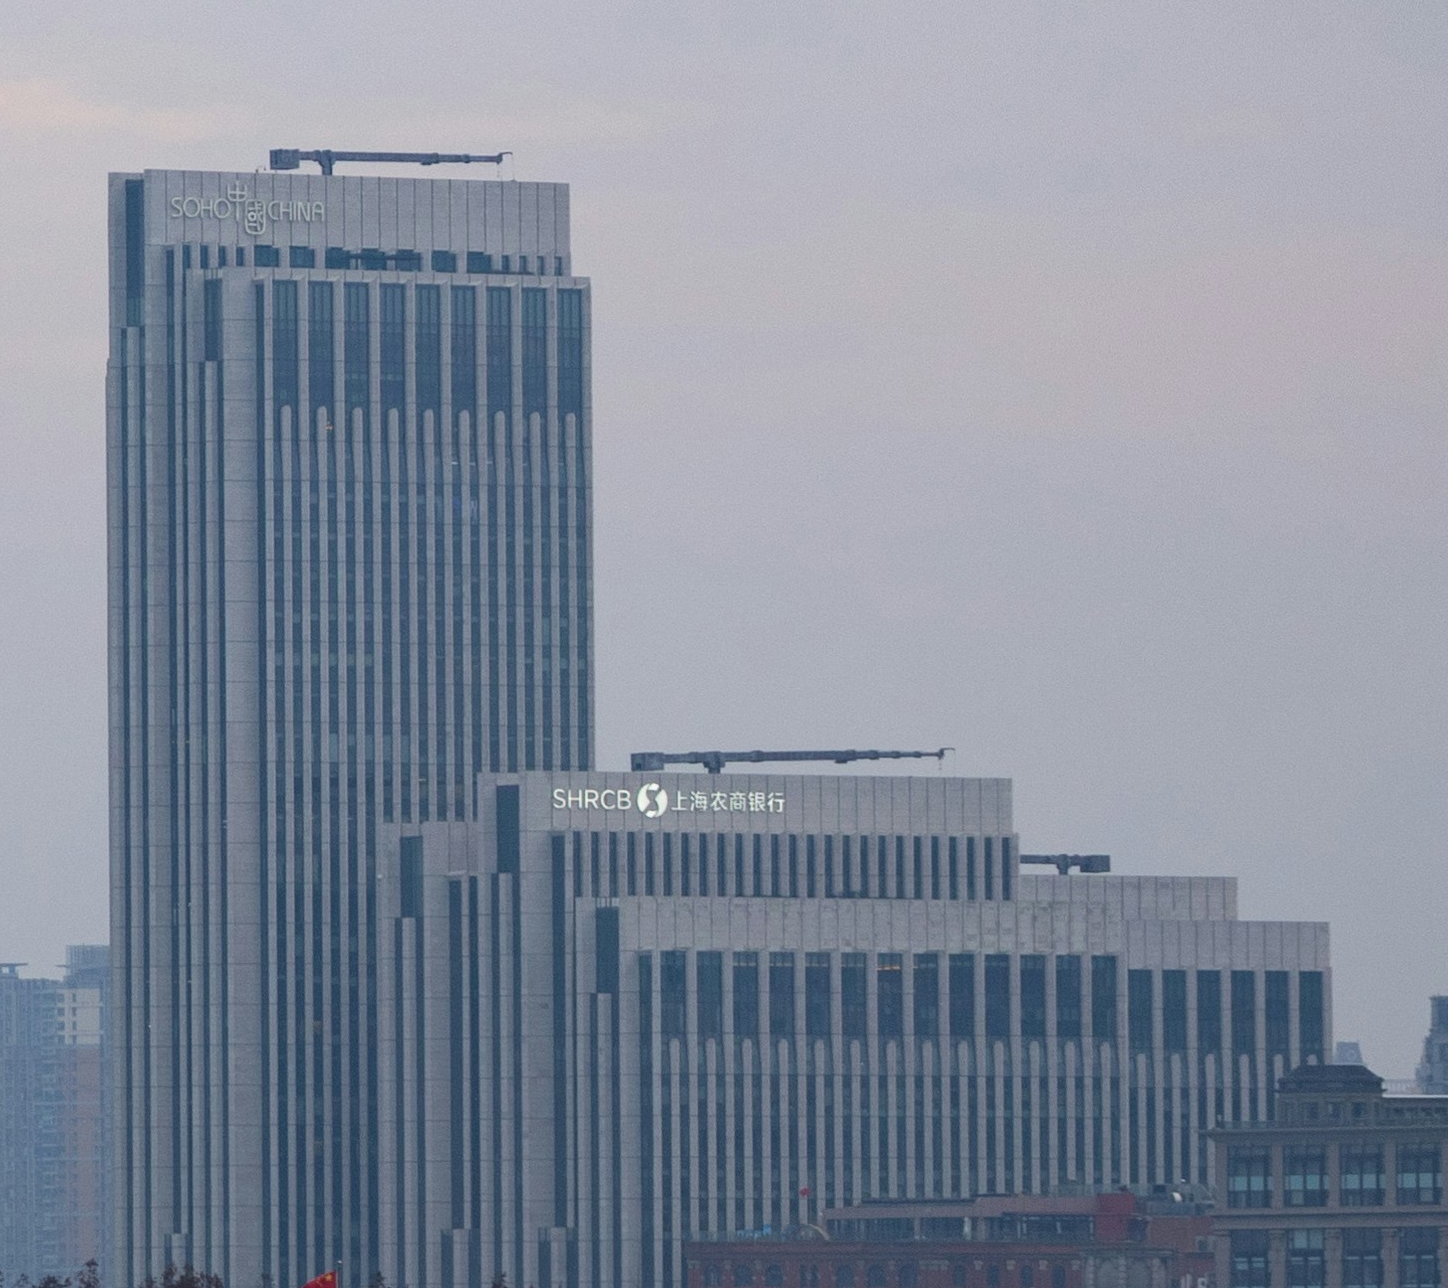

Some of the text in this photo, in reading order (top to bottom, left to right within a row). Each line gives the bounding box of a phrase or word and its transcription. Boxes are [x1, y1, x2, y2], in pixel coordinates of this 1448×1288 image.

[171, 196, 232, 219] SOHO
[268, 199, 326, 222] CHINA
[553, 788, 786, 813] SHRCB 上海农商银行
